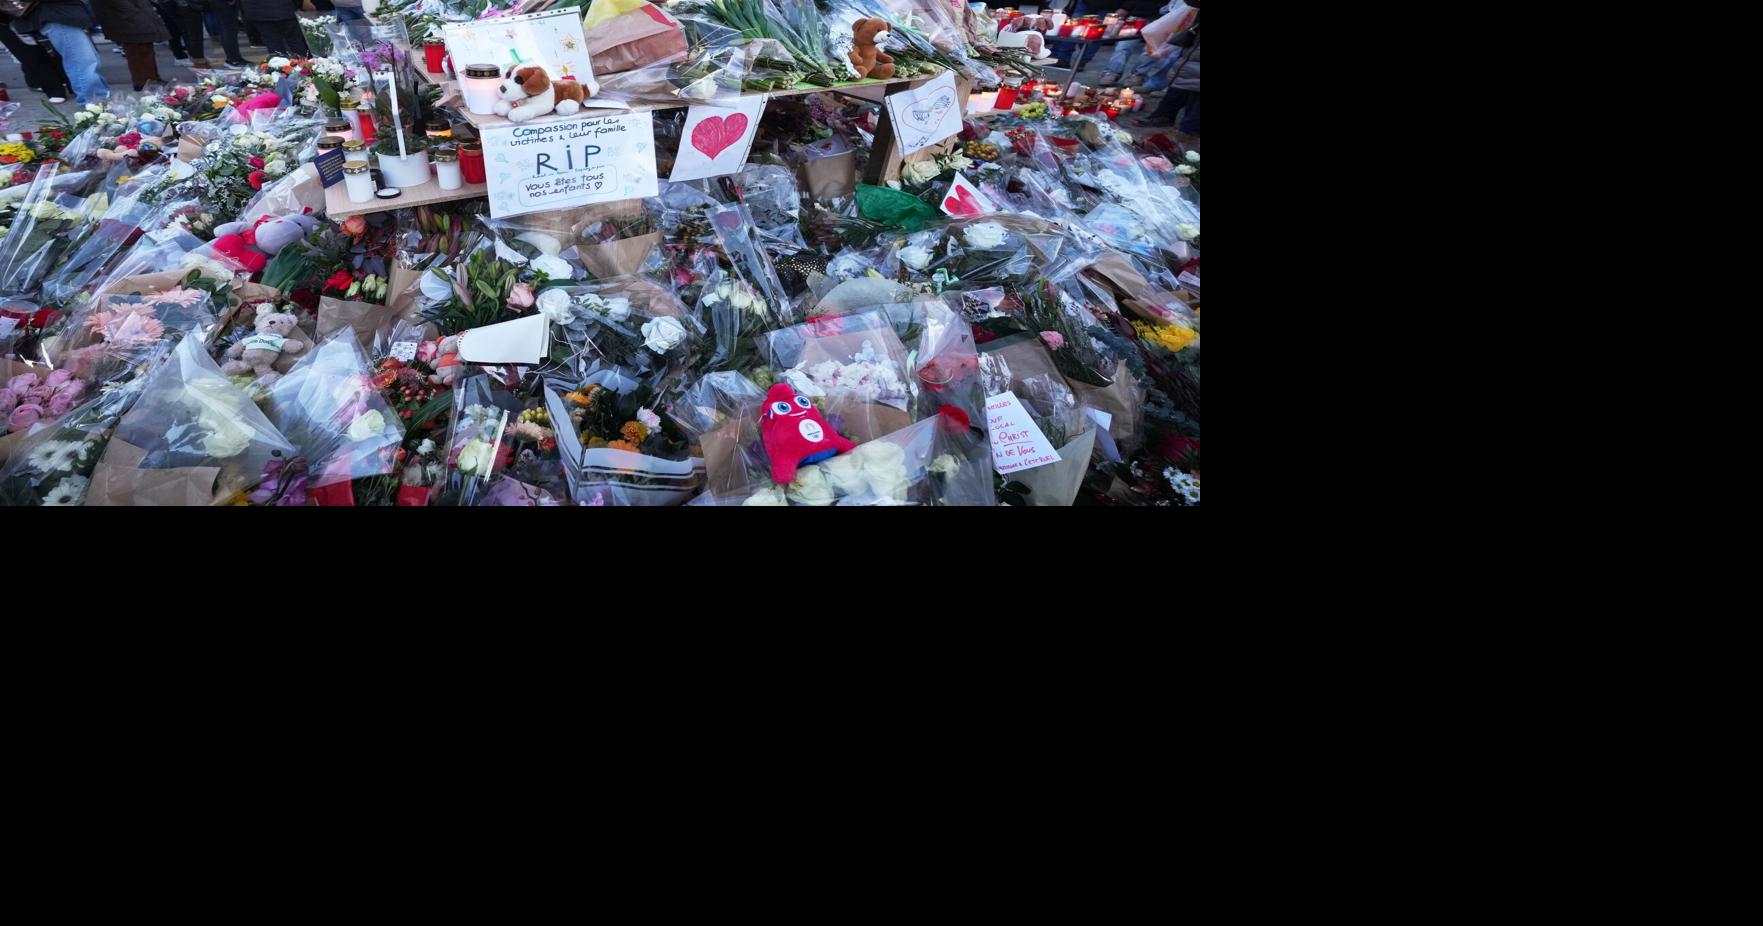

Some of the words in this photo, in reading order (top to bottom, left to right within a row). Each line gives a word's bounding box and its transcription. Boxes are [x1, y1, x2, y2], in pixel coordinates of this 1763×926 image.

[510, 135, 554, 147] victimes
[594, 125, 627, 138] famille
[512, 123, 578, 139] Compassion
[581, 120, 601, 131] pour
[529, 190, 548, 198] nos
